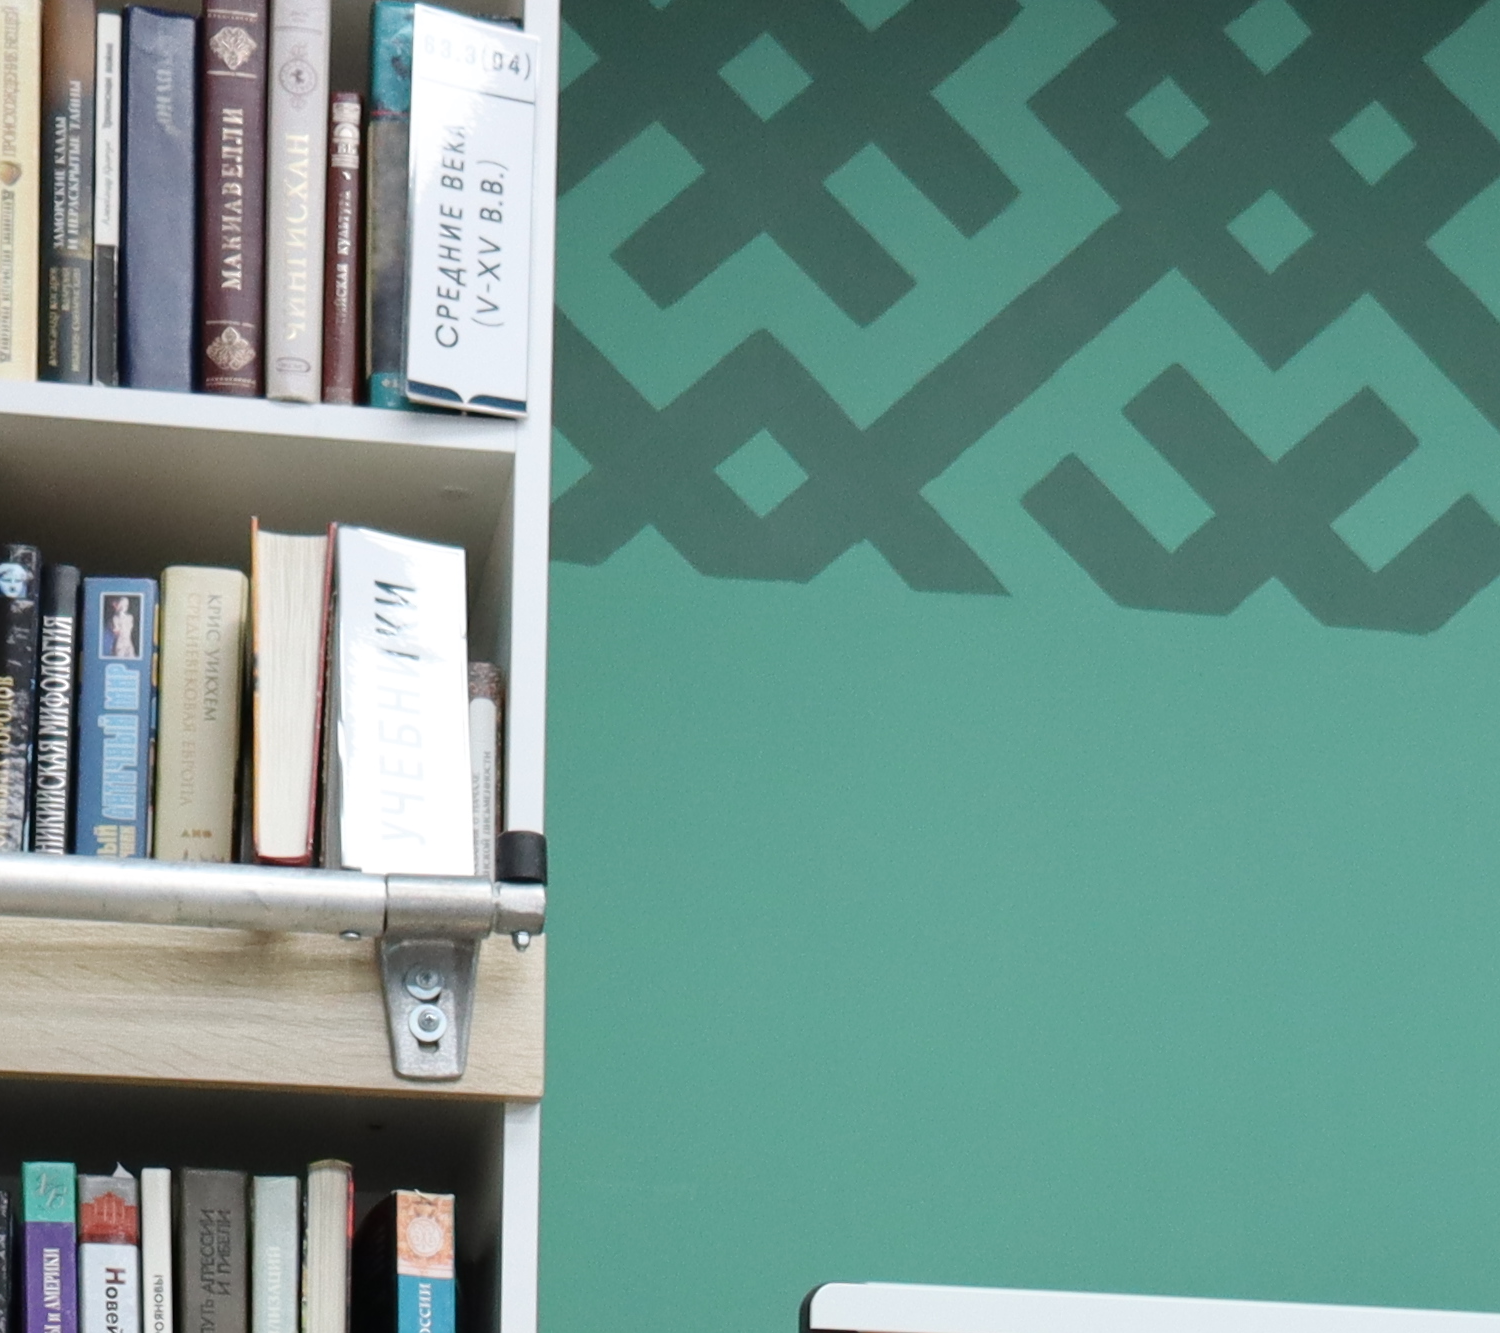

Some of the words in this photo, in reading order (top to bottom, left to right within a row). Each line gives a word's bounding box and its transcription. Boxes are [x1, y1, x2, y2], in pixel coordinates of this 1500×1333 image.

[220, 107, 245, 290] МАКИАВЕЛЛИ
[440, 123, 468, 192] ВЕКА
[285, 131, 309, 342] ЧИНГИСХАН
[435, 206, 468, 348] СРЕДНИЕ
[37, 615, 72, 735] МИФОЛОГИЯ
